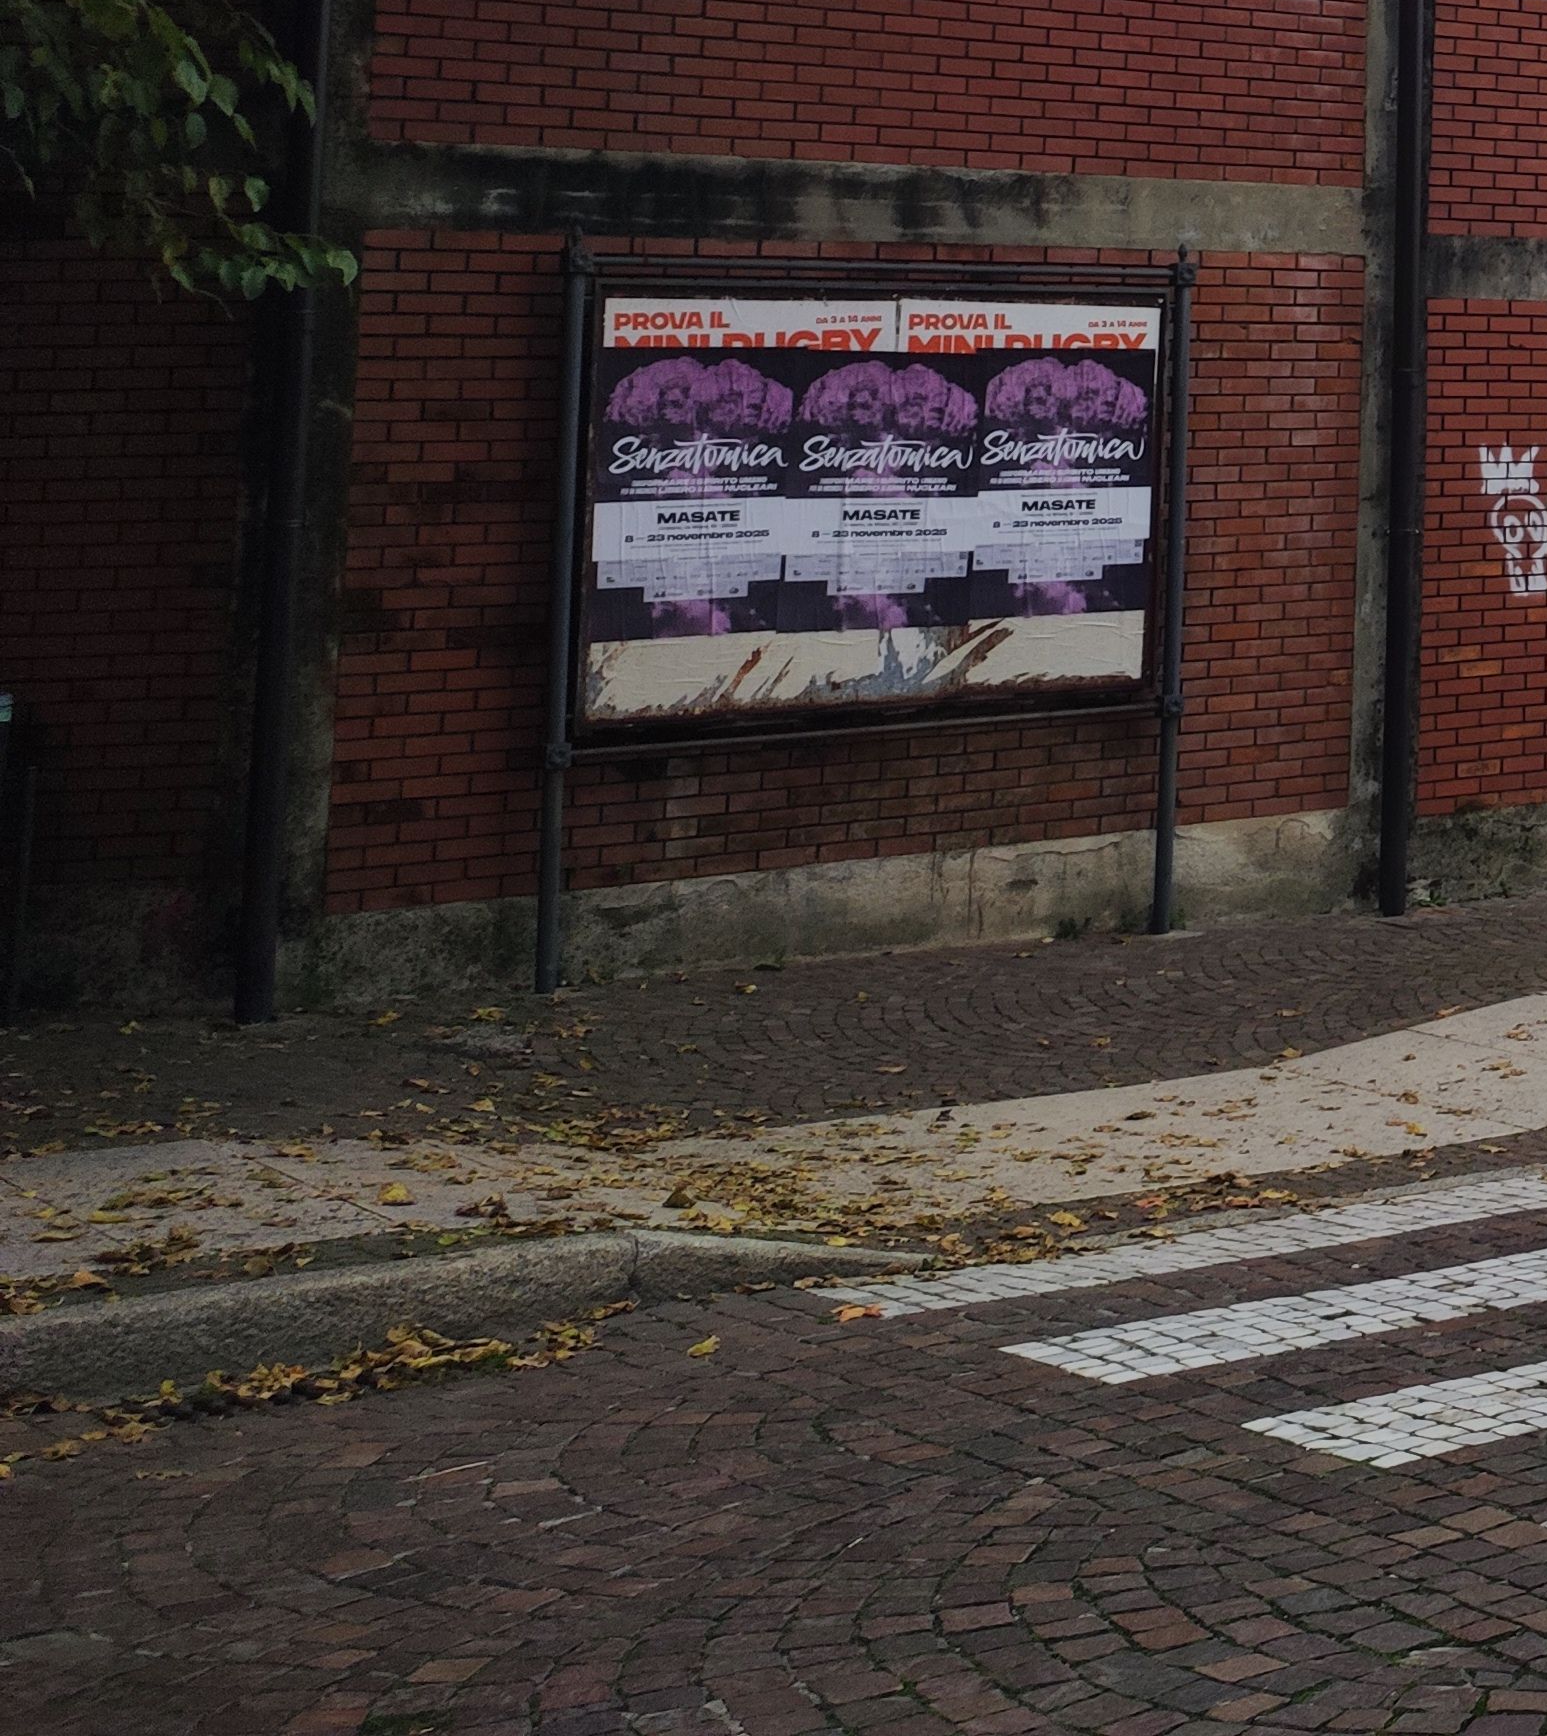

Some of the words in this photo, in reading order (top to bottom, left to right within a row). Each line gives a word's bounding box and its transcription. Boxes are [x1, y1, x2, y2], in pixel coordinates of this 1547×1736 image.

[614, 312, 704, 331] PROVA
[710, 311, 731, 329] IL
[831, 316, 837, 324] 3
[909, 313, 989, 330] PROVA
[994, 313, 1012, 329] IL
[980, 427, 1144, 466] Senzatomica
[608, 433, 788, 474] Senzatomica
[799, 434, 973, 474] Senzatomica
[1021, 499, 1096, 512] MASATE
[657, 510, 740, 524] MASATE
[842, 509, 920, 521] MASATE
[1030, 519, 1090, 527] novembre
[647, 533, 665, 542] 23
[667, 531, 733, 541] novembre
[832, 530, 849, 538] 23
[850, 528, 913, 538] novembre
